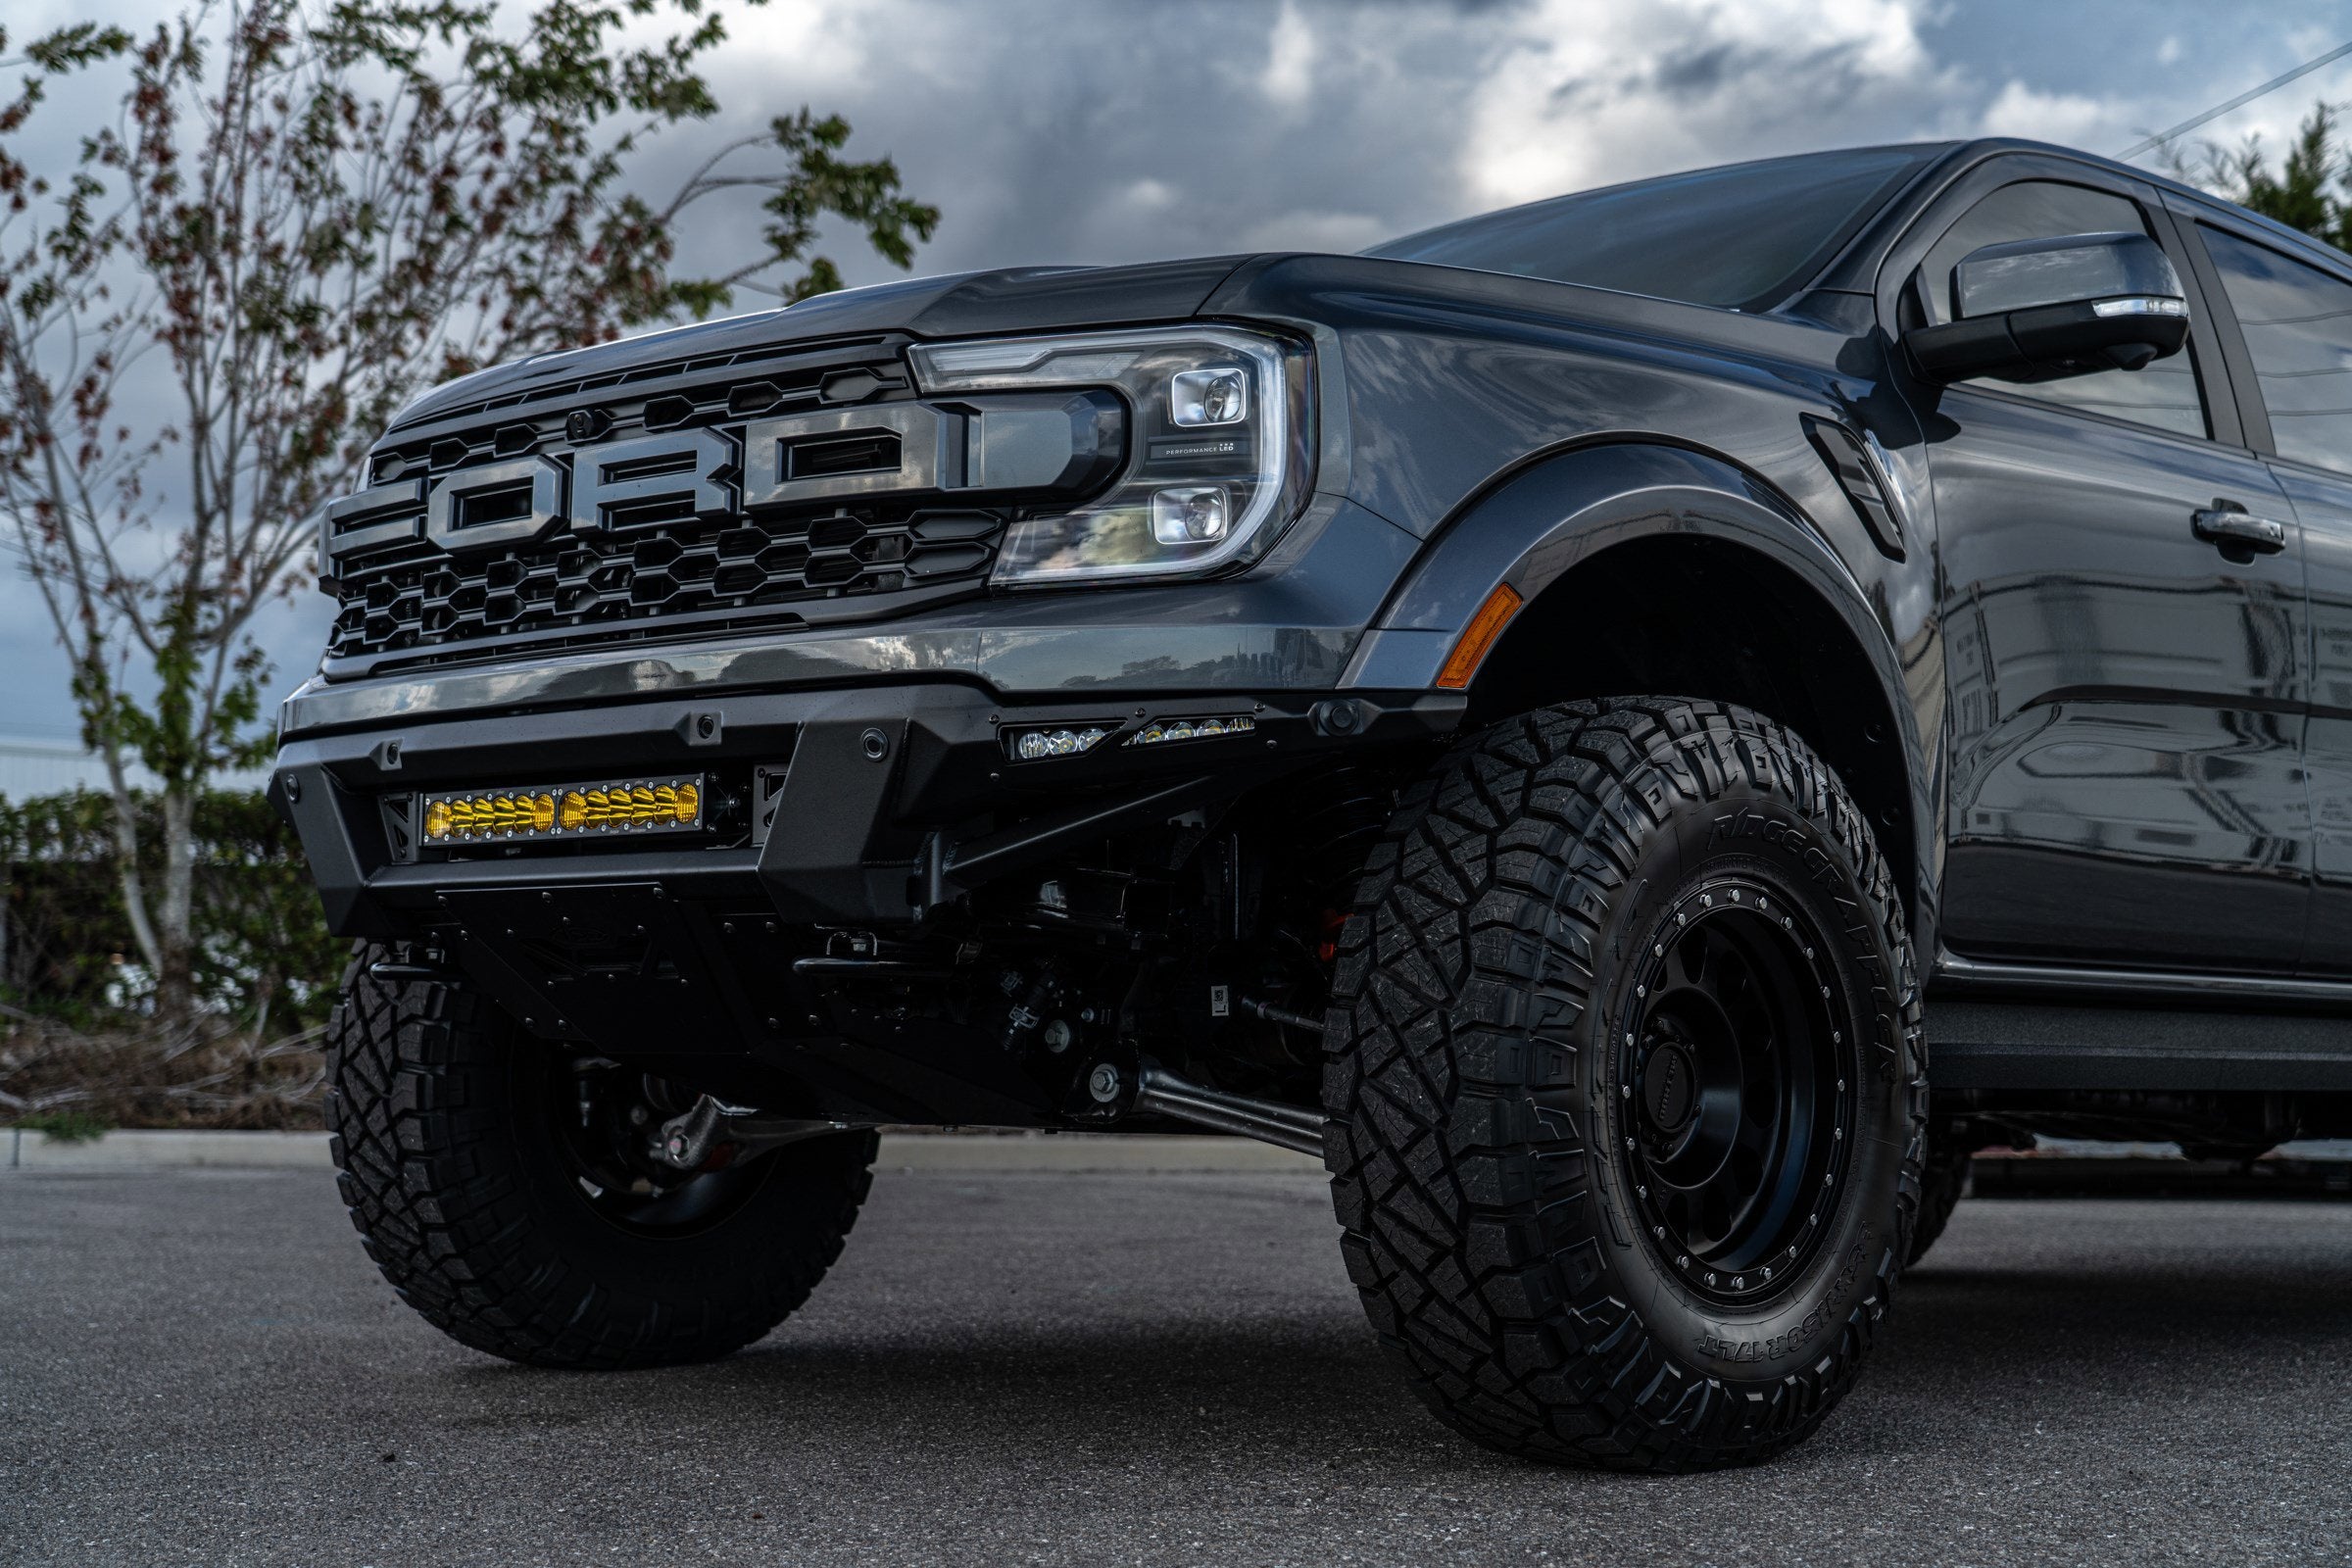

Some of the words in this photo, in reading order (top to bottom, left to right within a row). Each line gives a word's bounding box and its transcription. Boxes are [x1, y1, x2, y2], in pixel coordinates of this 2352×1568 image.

[1165, 447, 1217, 456] PERFORMANCE
[320, 400, 968, 584] FORD
[1706, 807, 1807, 857] RIDGE
